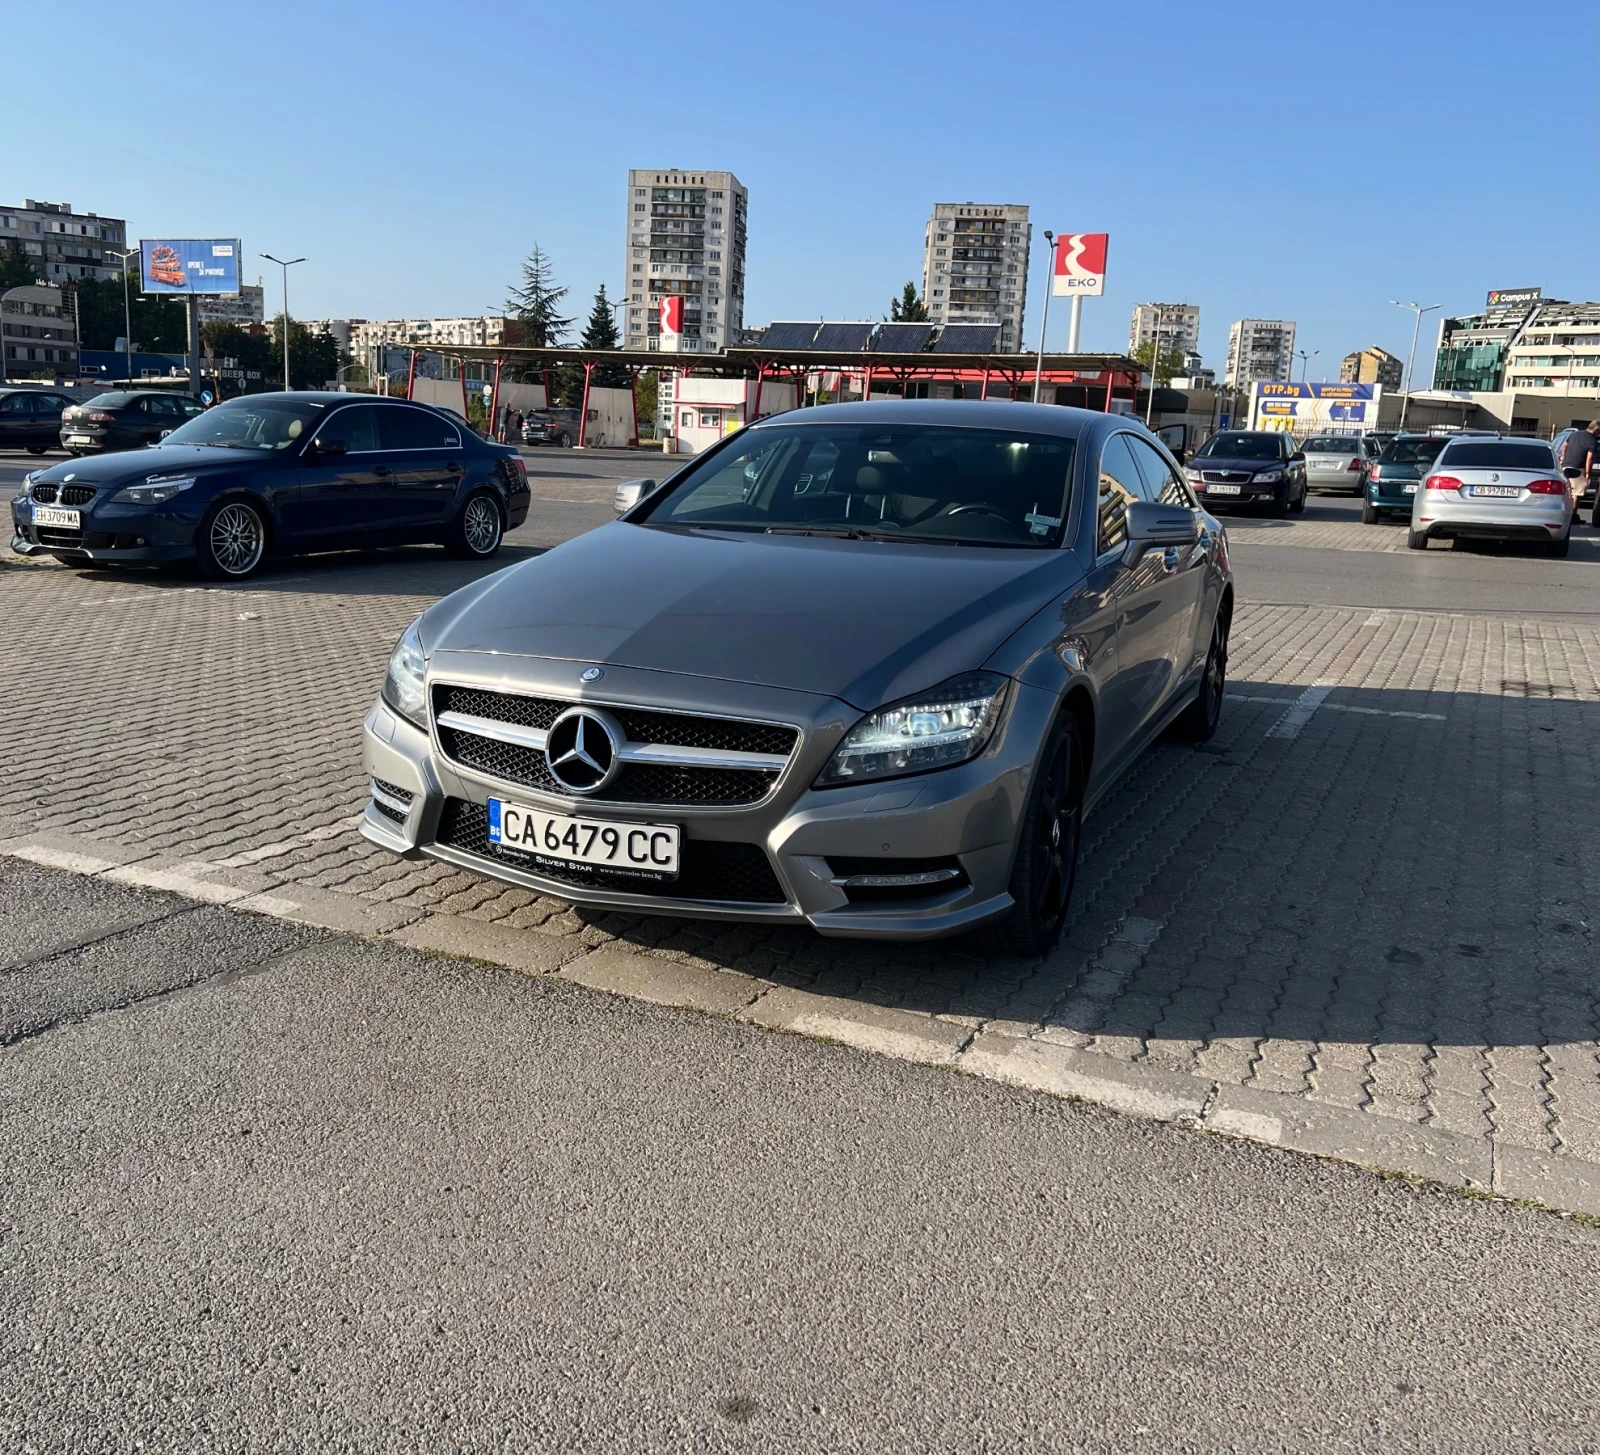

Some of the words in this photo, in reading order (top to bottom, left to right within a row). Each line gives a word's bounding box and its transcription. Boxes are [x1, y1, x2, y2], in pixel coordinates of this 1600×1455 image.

[1068, 278, 1097, 287] EKO
[1500, 293, 1531, 303] Campus
[1532, 291, 1538, 300] X
[222, 369, 244, 379] BEER
[246, 370, 261, 380] BOX
[1263, 384, 1300, 397] GTP.bg
[1475, 486, 1485, 495] CB
[1506, 487, 1517, 496] HC
[36, 510, 46, 521] EH
[47, 510, 66, 523] 3709
[67, 512, 79, 524] MA
[490, 826, 500, 836] BG
[504, 810, 537, 847] CA
[544, 820, 620, 860] 6479
[627, 830, 673, 865] CC
[535, 855, 565, 868] SILVER
[568, 862, 593, 872] STAR
